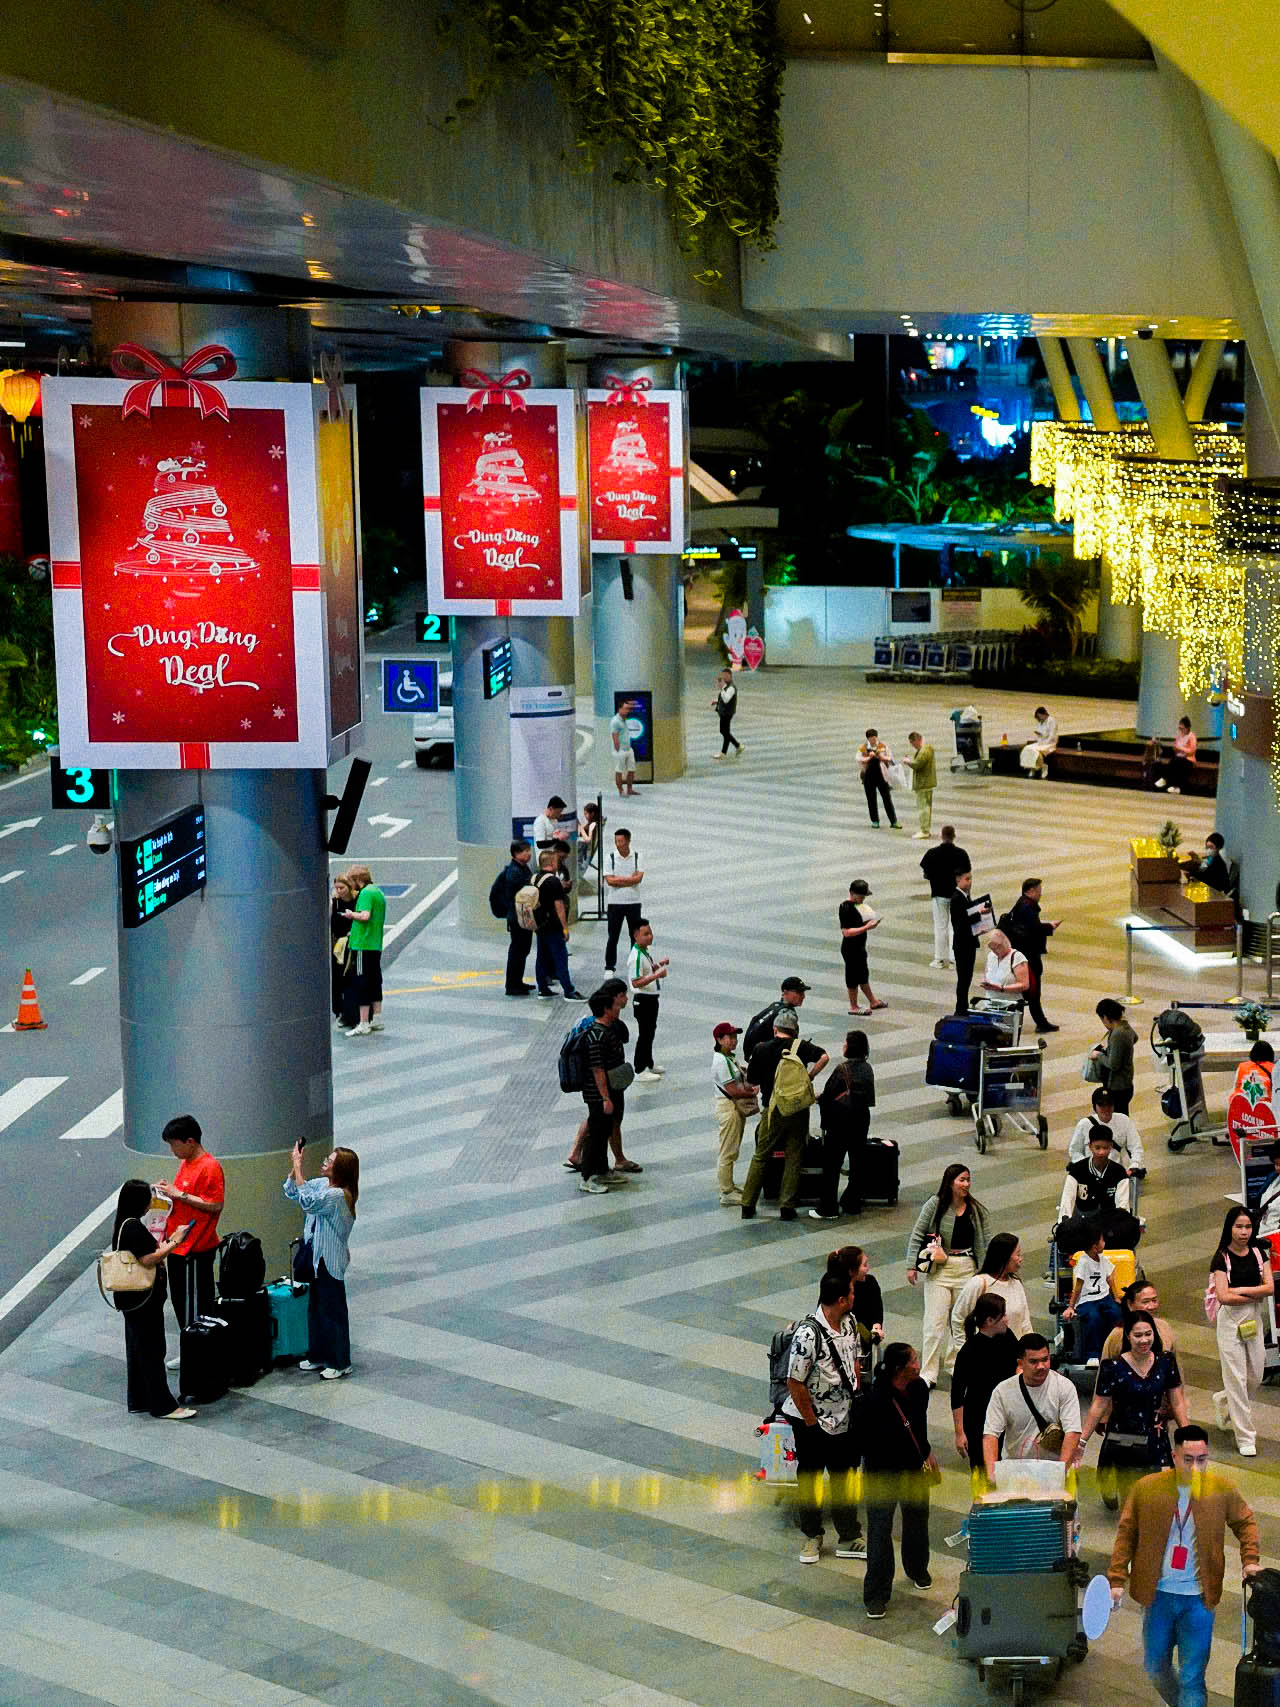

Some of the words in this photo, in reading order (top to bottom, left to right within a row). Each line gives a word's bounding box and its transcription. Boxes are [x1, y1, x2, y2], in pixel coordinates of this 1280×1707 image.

[616, 504, 658, 521] Deal
[453, 529, 506, 550] Ding
[482, 547, 541, 571] Deal
[107, 624, 199, 657] Ding
[423, 614, 442, 641] 2
[159, 653, 260, 694] Deal
[65, 768, 95, 803] 3
